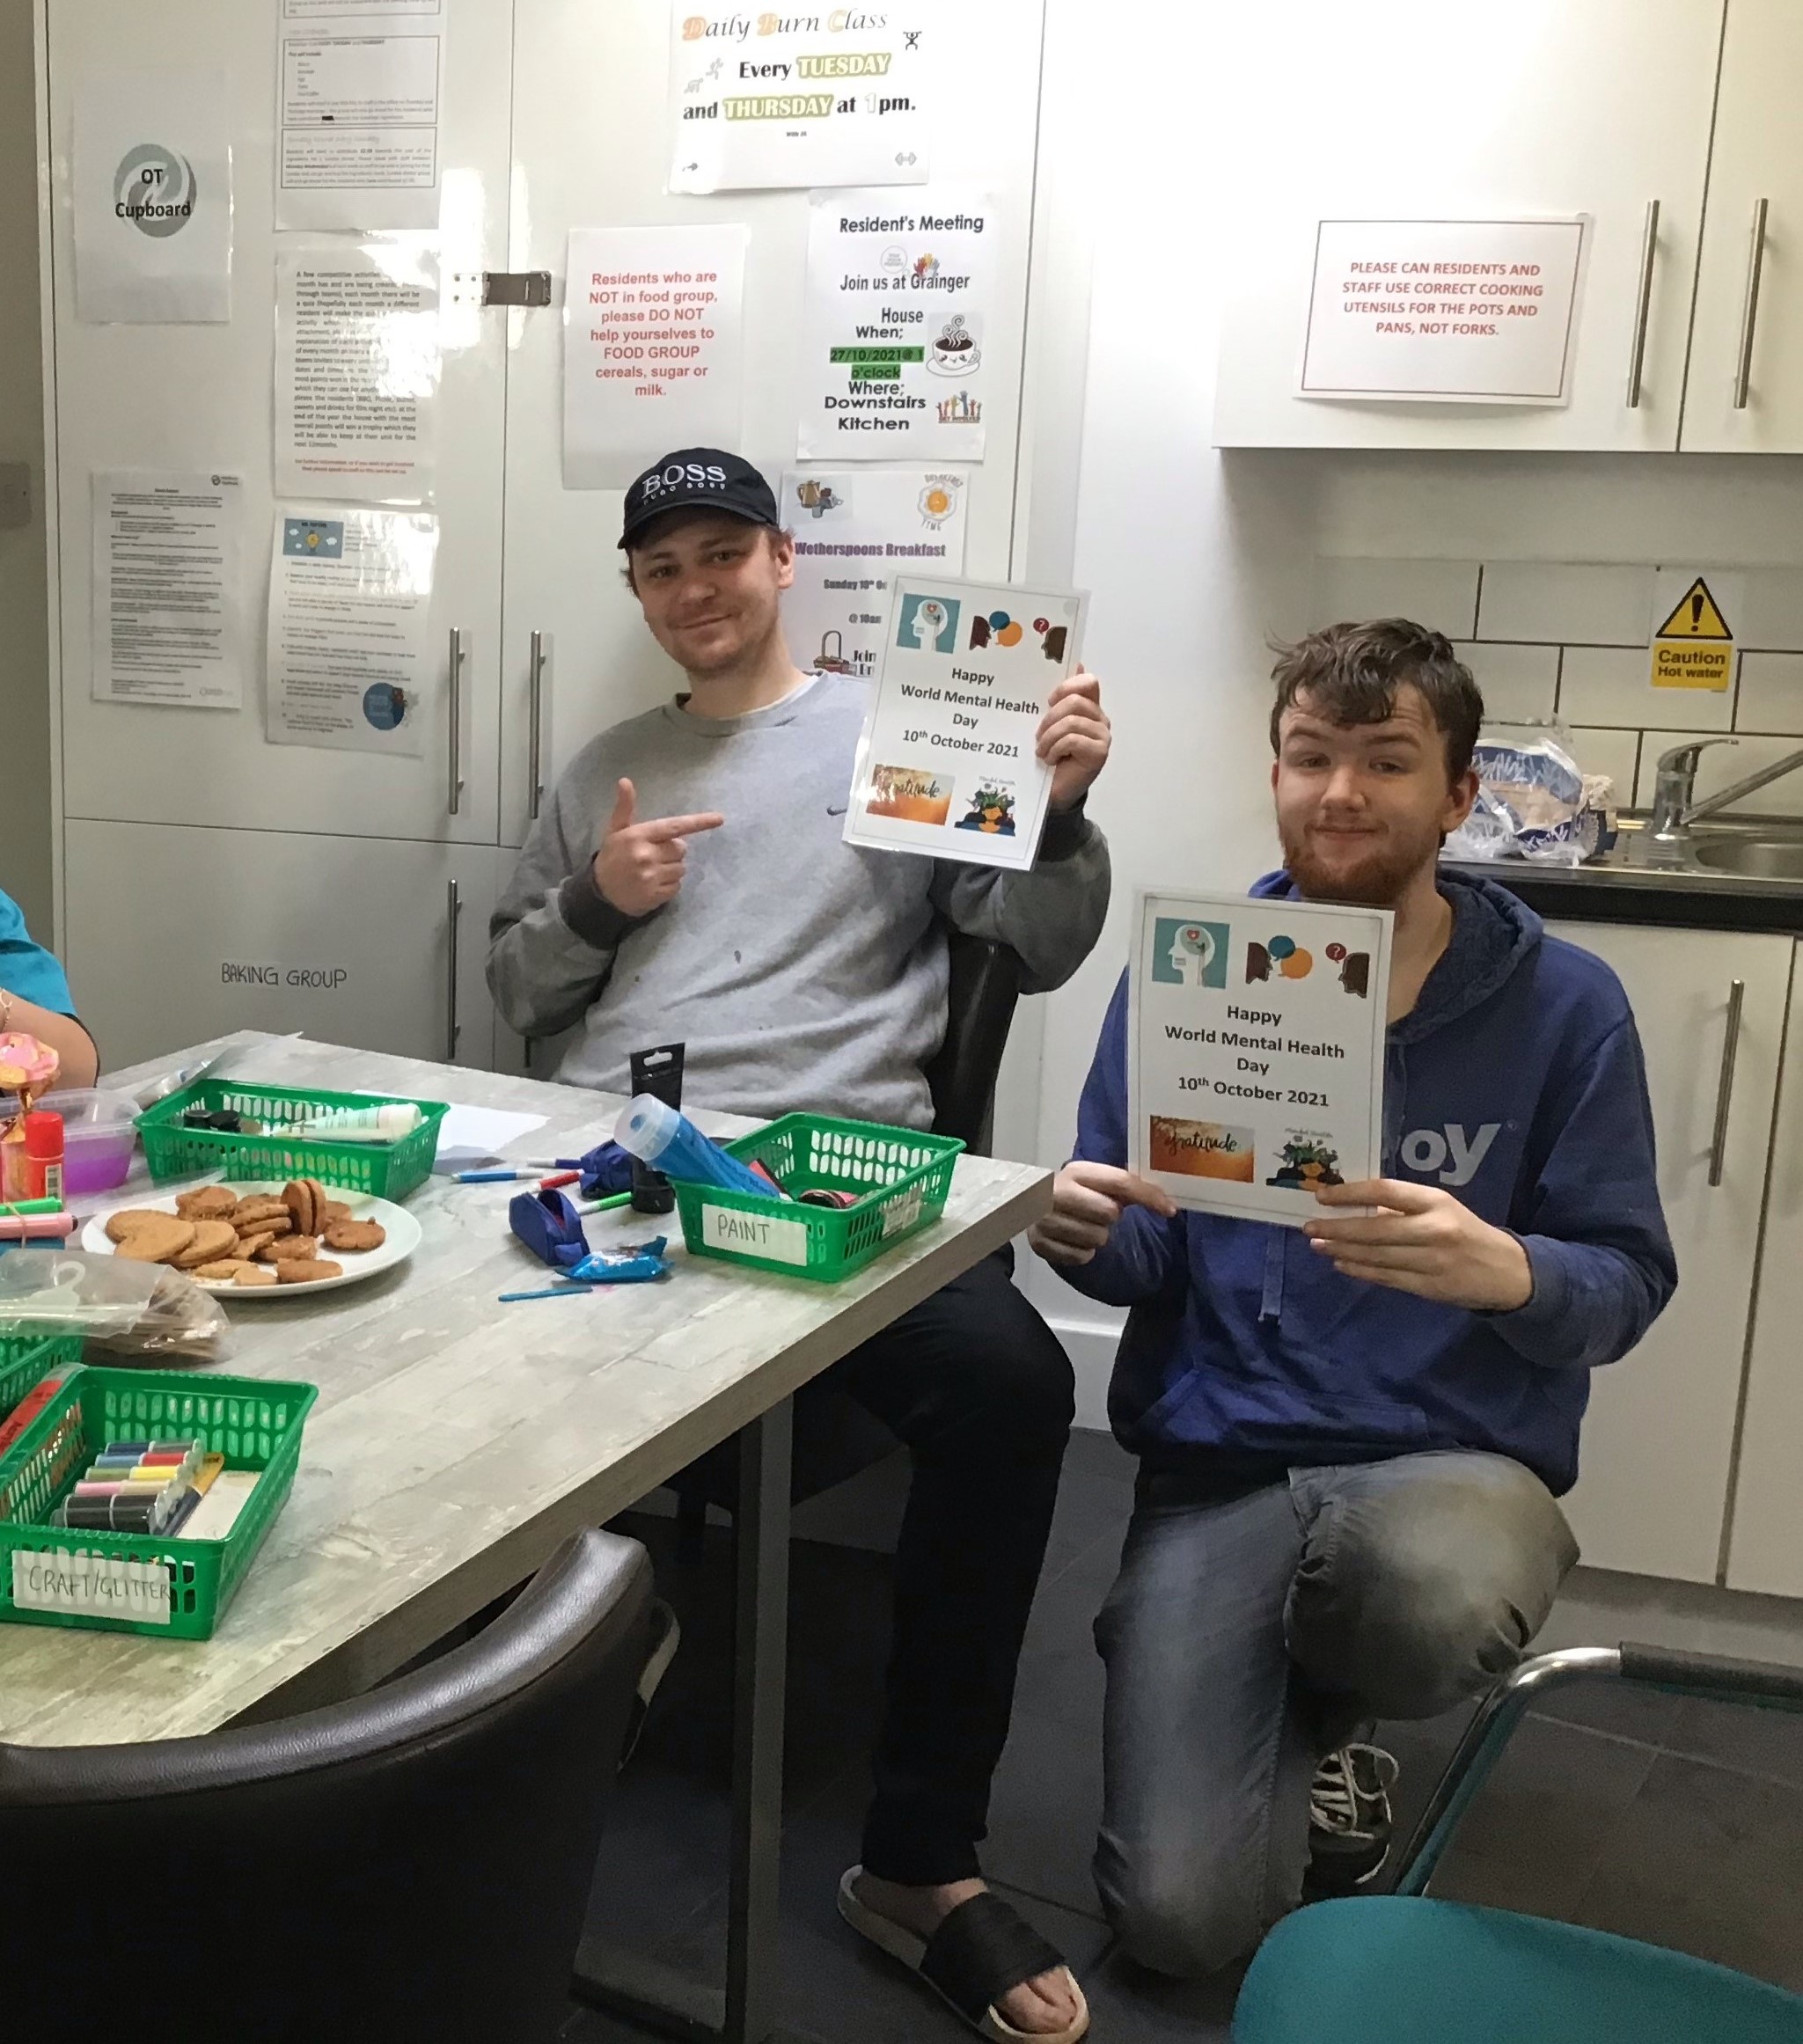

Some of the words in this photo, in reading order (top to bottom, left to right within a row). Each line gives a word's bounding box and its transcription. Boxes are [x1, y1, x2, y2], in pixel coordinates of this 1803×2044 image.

[682, 13, 751, 42] Daily
[757, 13, 819, 36] Burn
[828, 8, 888, 33] Class
[739, 62, 792, 81] Every
[797, 54, 891, 78] TUESDAY
[683, 101, 718, 120] and
[724, 95, 833, 120] THURSDAY
[837, 97, 856, 114] at
[141, 168, 164, 184] OT
[115, 200, 191, 221] Cupboard
[839, 216, 915, 233] Resident's
[919, 215, 984, 233] Meeting
[1351, 262, 1398, 274] PLEASE
[1401, 262, 1430, 274] CAN
[1433, 263, 1506, 275] RESIDENTS
[1509, 264, 1541, 276] AND
[591, 273, 658, 286] Residents
[663, 271, 692, 283] who
[695, 273, 717, 282] are
[839, 275, 869, 290] Join
[872, 278, 888, 289] us
[892, 275, 906, 289] at
[911, 273, 971, 293] Grainger
[589, 291, 619, 304] NOT
[622, 291, 634, 303] in
[639, 290, 670, 303] food
[673, 291, 718, 304] group,
[1343, 282, 1382, 293] STAFF
[1385, 282, 1411, 294] USE
[1414, 283, 1476, 295] CORRECT
[1479, 284, 1543, 297] COOKING
[601, 311, 645, 325] please
[649, 309, 671, 321] DO
[674, 308, 705, 321] NOT
[881, 307, 924, 324] House
[1344, 302, 1405, 313] UTENSILS
[1409, 303, 1436, 314] FOR
[1440, 304, 1465, 315] THE
[1469, 304, 1504, 316] POTS
[1506, 304, 1538, 317] AND
[590, 329, 619, 343] help
[623, 327, 697, 343] yourselves
[700, 327, 715, 339] to
[855, 326, 904, 340] When;
[1375, 322, 1416, 335] PANS,
[1418, 323, 1448, 334] NOT
[1452, 323, 1499, 335] FORKS.
[604, 347, 644, 360] FOOD
[648, 345, 700, 359] GROUP
[595, 366, 648, 378] cereals,
[650, 367, 690, 380] sugar
[693, 366, 708, 377] or
[851, 366, 901, 379] o'clock
[634, 384, 667, 396] milk.
[848, 380, 905, 397] Where;
[825, 396, 927, 409] Downstairs
[838, 417, 910, 430] Kitchen
[641, 464, 727, 499] BOSS
[795, 542, 883, 557] Wetherspoons
[886, 543, 946, 557] Breakfast
[1659, 649, 1726, 665] Caution
[951, 668, 994, 686] Happy
[1658, 666, 1682, 678] Hot
[1686, 667, 1724, 678] water
[901, 684, 941, 700] World
[944, 691, 993, 708] Mental
[995, 697, 1040, 714] Health
[952, 713, 978, 729] Day
[902, 729, 928, 743] 10th
[930, 734, 984, 752] October
[986, 742, 1019, 758] 2021
[221, 963, 278, 985] BAKING
[286, 969, 348, 988] GROUP
[1227, 1005, 1282, 1026] Happy
[1164, 1025, 1216, 1044] World
[1221, 1032, 1282, 1051] Mental
[1287, 1039, 1345, 1059] Health
[1236, 1058, 1270, 1076] Day
[1178, 1076, 1209, 1091] 10th
[1213, 1081, 1283, 1101] October
[1287, 1089, 1330, 1107] 2021
[1401, 1124, 1501, 1186] oy
[717, 1213, 770, 1244] PAINT
[29, 1565, 171, 1599] CRAFT/GLITTER
